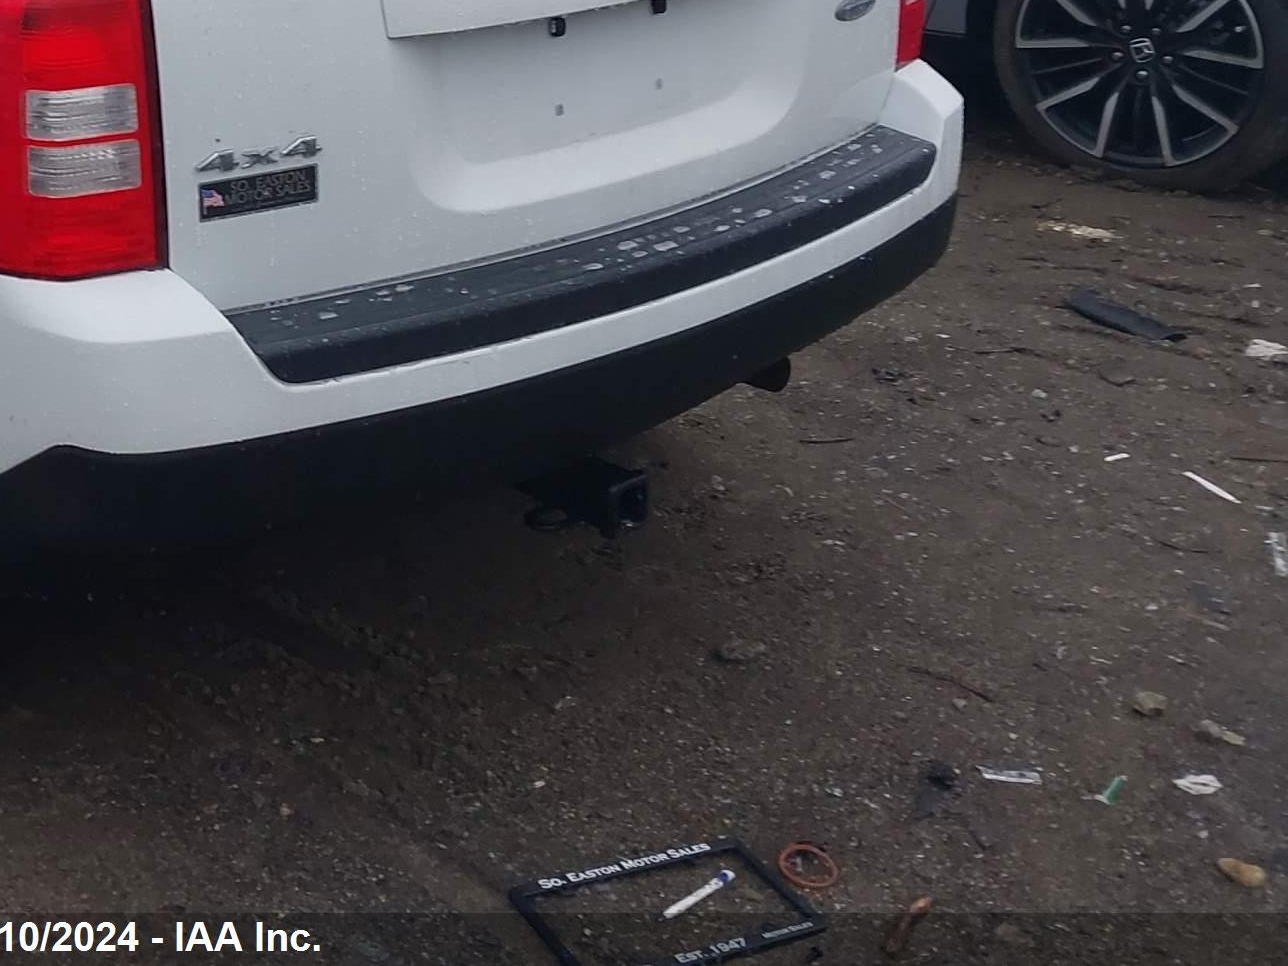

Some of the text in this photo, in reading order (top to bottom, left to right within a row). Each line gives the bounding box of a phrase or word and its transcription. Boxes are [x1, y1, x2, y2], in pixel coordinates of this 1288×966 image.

[195, 134, 323, 172] 4x4
[256, 170, 306, 188] EASTON
[224, 187, 272, 206] MOTOR
[275, 181, 311, 197] SALES
[710, 938, 747, 955] 1947
